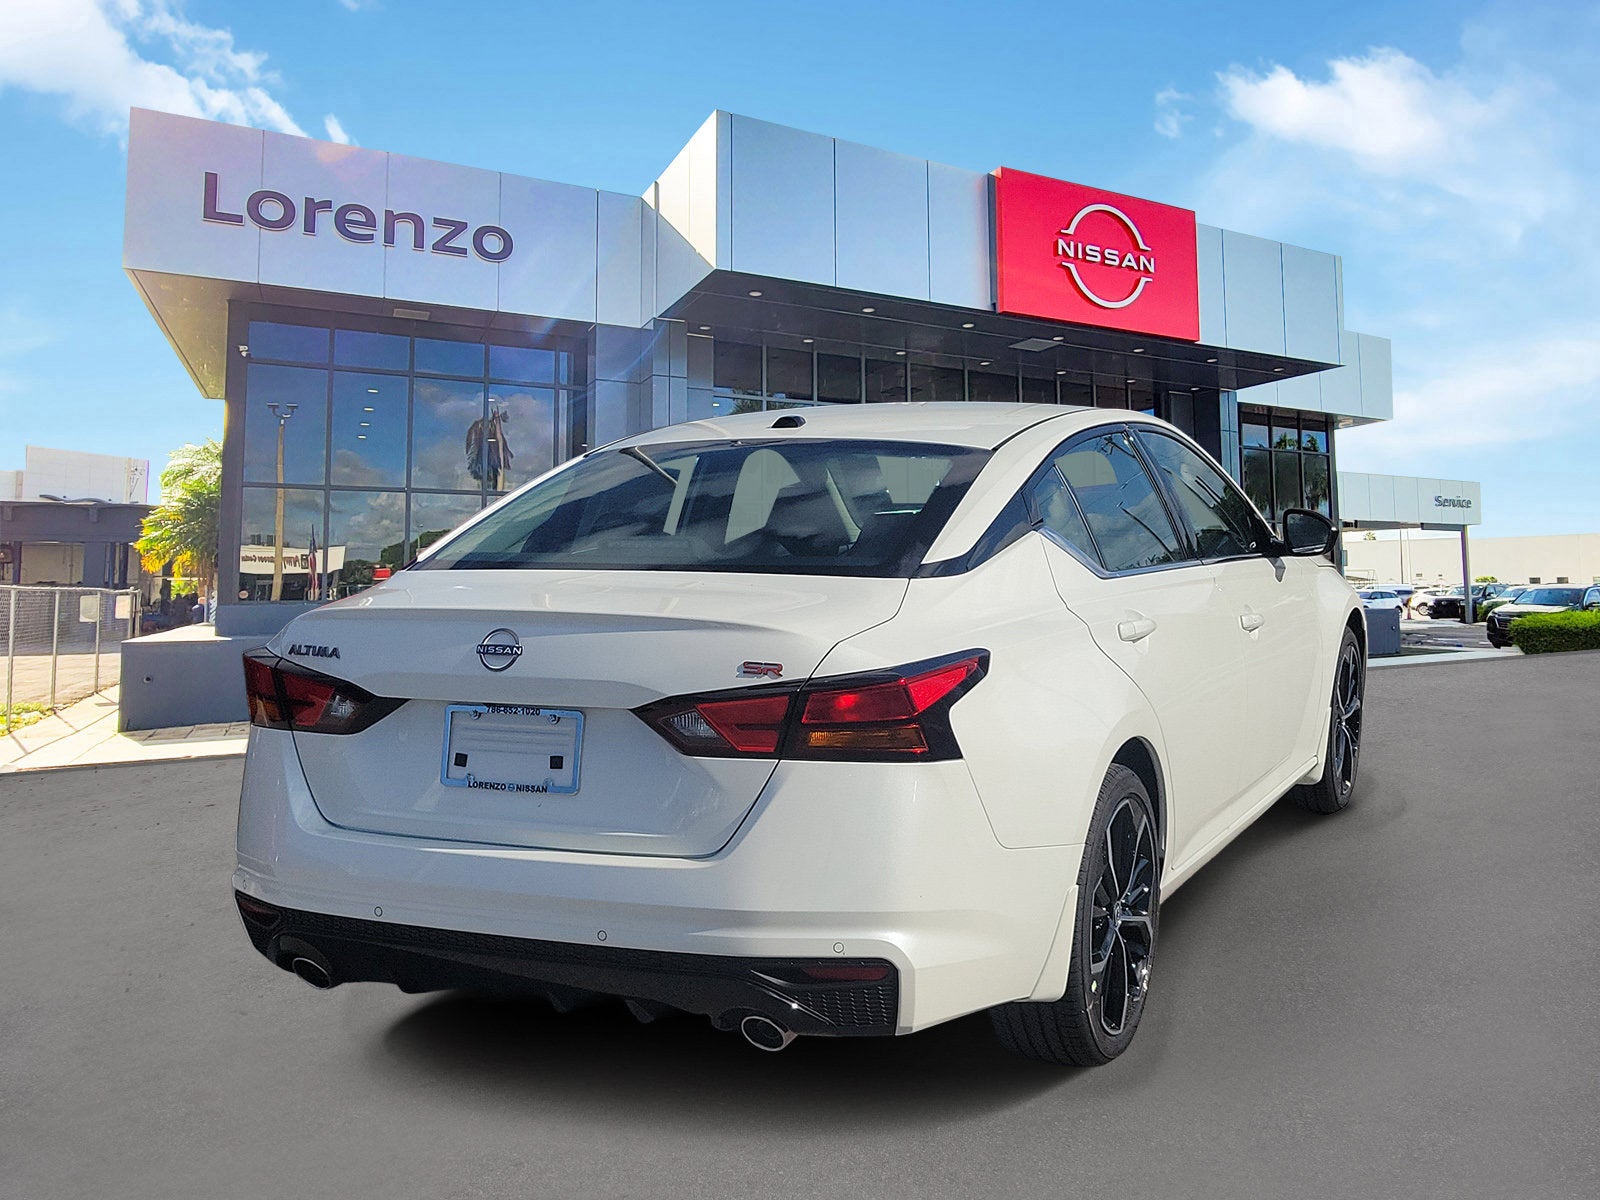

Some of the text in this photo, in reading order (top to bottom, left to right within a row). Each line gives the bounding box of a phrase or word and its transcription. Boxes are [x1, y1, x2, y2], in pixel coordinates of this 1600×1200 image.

[202, 171, 514, 263] Lorenzo
[1056, 238, 1155, 274] NISSAN
[1434, 495, 1472, 509] Service
[288, 644, 340, 659] ALTIMA
[477, 645, 522, 655] NISSAN
[740, 661, 783, 678] SR
[487, 706, 541, 716] 786-652-1020
[467, 781, 548, 793] LORENZO NISSAN
